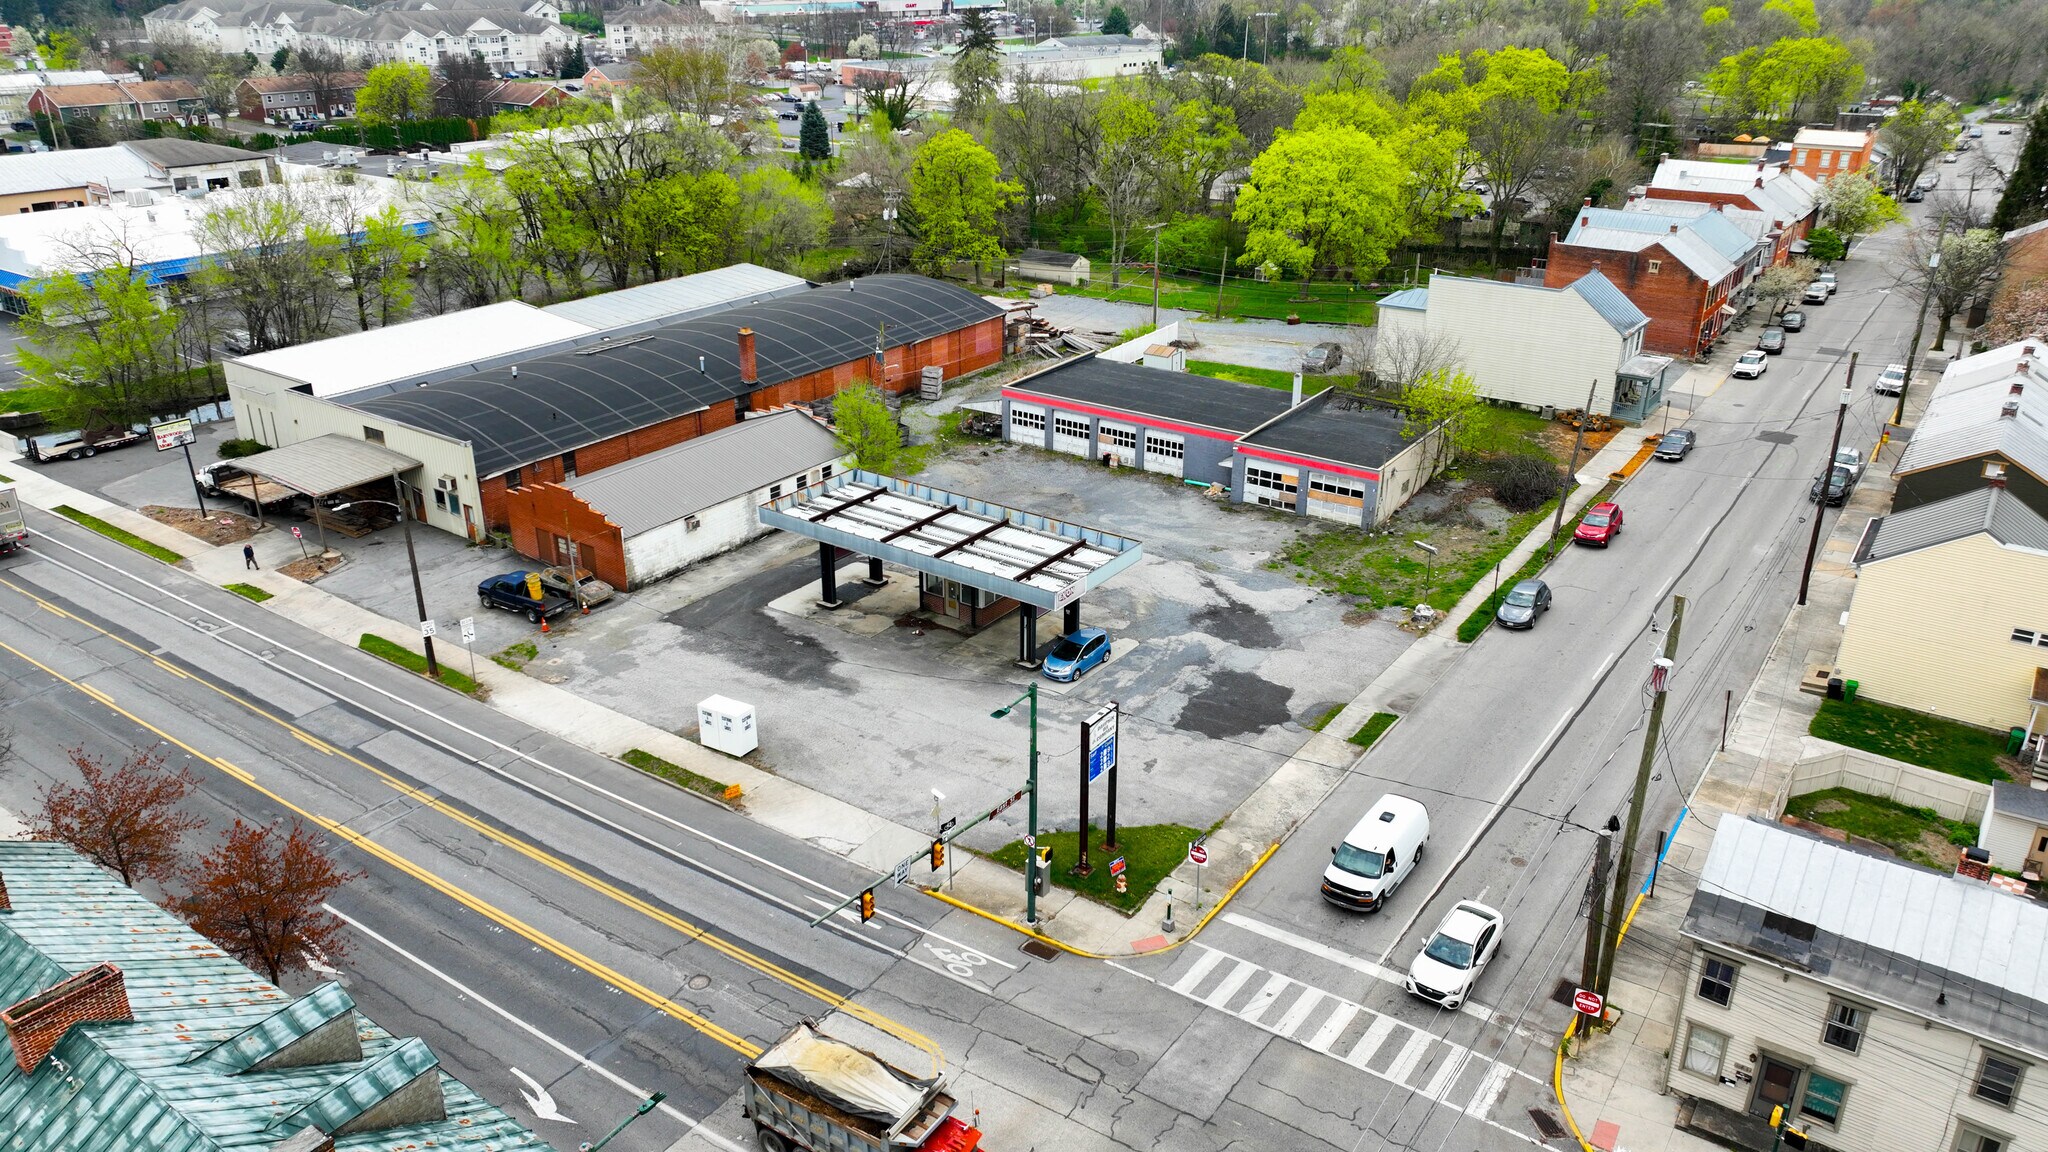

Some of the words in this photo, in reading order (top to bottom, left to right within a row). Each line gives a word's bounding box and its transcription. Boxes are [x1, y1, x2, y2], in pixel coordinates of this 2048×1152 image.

[424, 628, 435, 636] 35
[897, 860, 908, 872] ONE
[897, 866, 908, 879] WAY
[1579, 1002, 1595, 1011] ENTER
